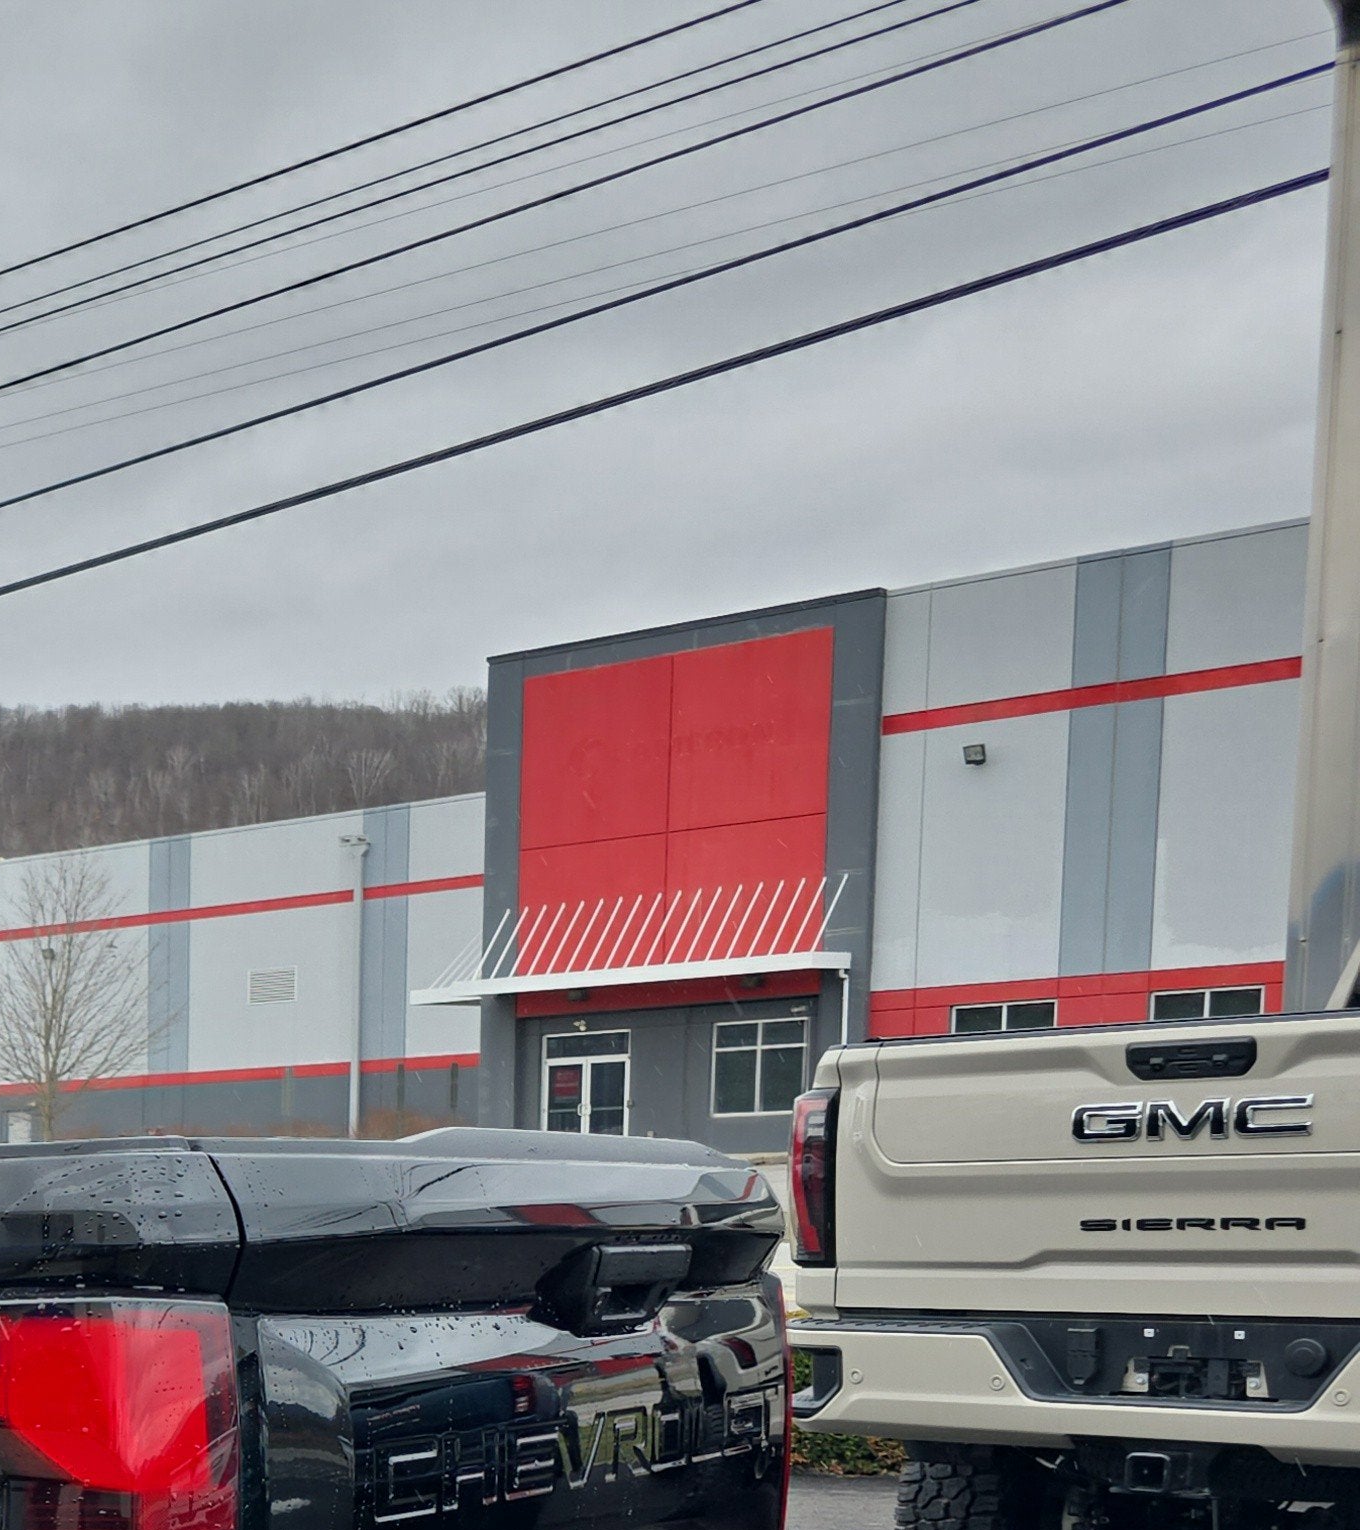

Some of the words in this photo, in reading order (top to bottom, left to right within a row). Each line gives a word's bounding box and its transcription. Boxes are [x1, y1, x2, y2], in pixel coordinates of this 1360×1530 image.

[1072, 1093, 1314, 1143] GMC
[1080, 1217, 1306, 1232] SIERRA
[373, 1383, 783, 1522] CHEVROLET
